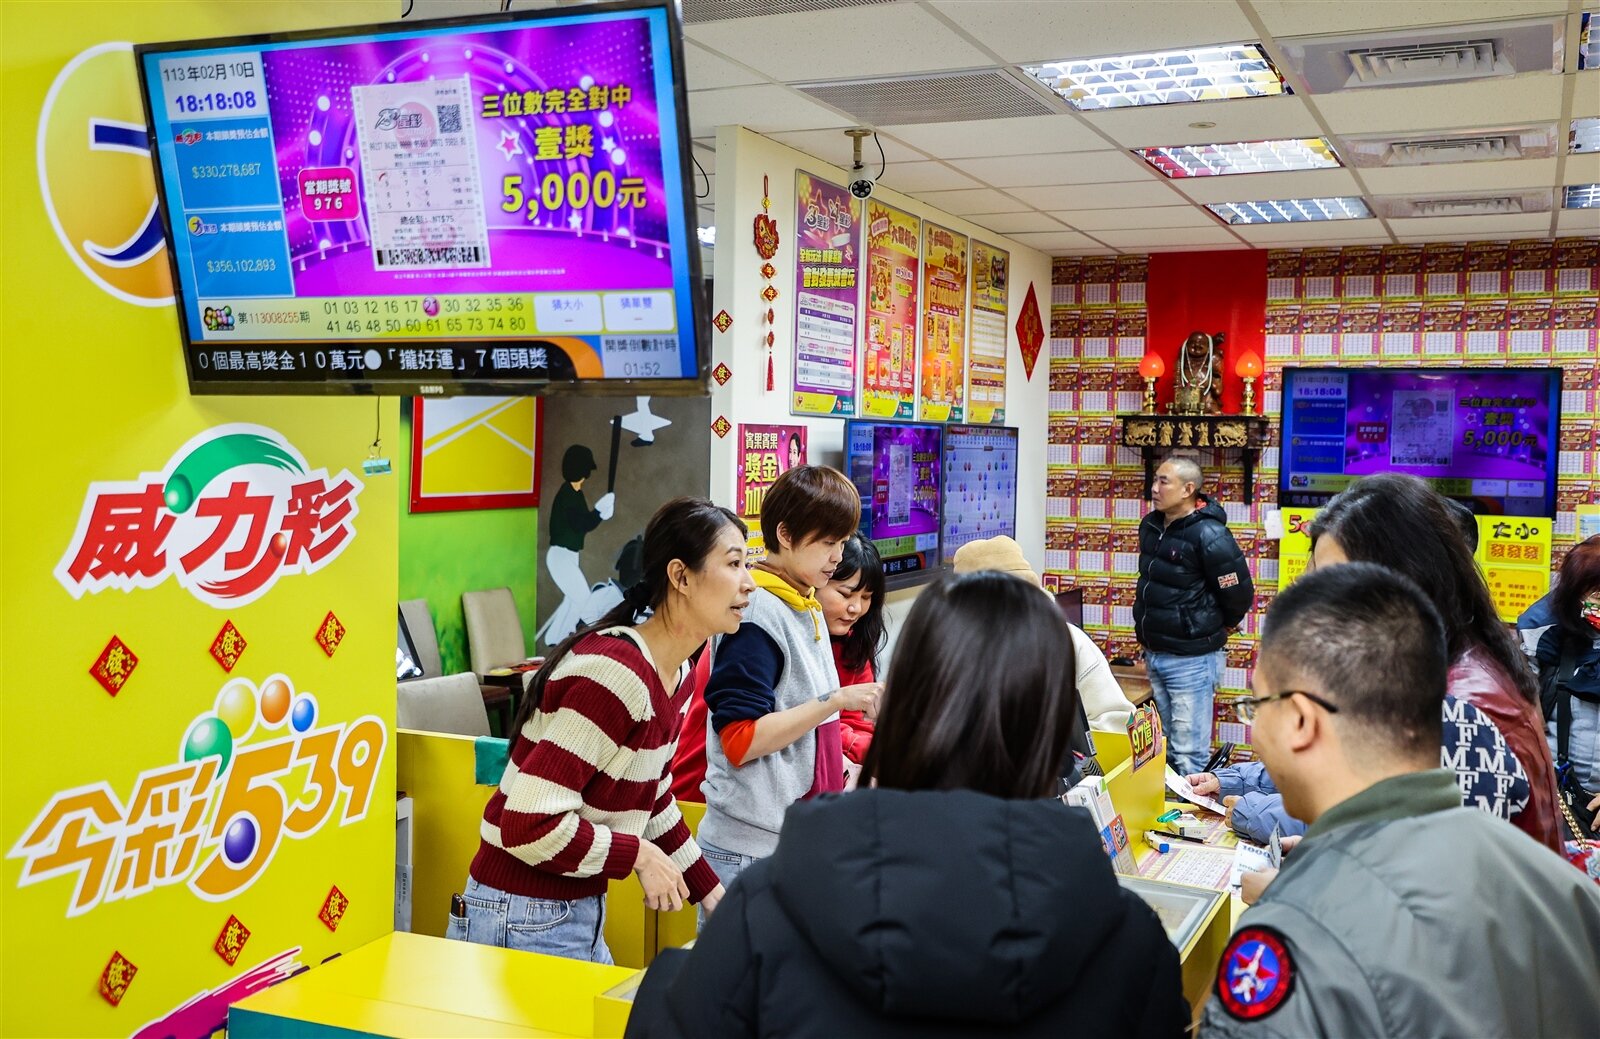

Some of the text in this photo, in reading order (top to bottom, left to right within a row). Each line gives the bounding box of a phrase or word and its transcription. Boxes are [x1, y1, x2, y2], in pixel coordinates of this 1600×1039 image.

[163, 61, 255, 82] 113年02月10日
[175, 90, 257, 113] 18:18:08
[480, 83, 632, 118] 三位數完全對中
[534, 125, 595, 161] 壹獎
[304, 179, 352, 195] 當期獎號
[501, 170, 648, 220] 5,000元
[324, 297, 524, 315] 01 03 12 16 17 21 30 32 35 36
[326, 316, 526, 333] 41 46 48 50 60 61 65 73 74 80
[623, 362, 661, 376] 01:52
[745, 432, 779, 450] 賓果賓果
[745, 452, 778, 483] 獎金
[745, 485, 768, 517] 加
[67, 478, 356, 598] 威力彩
